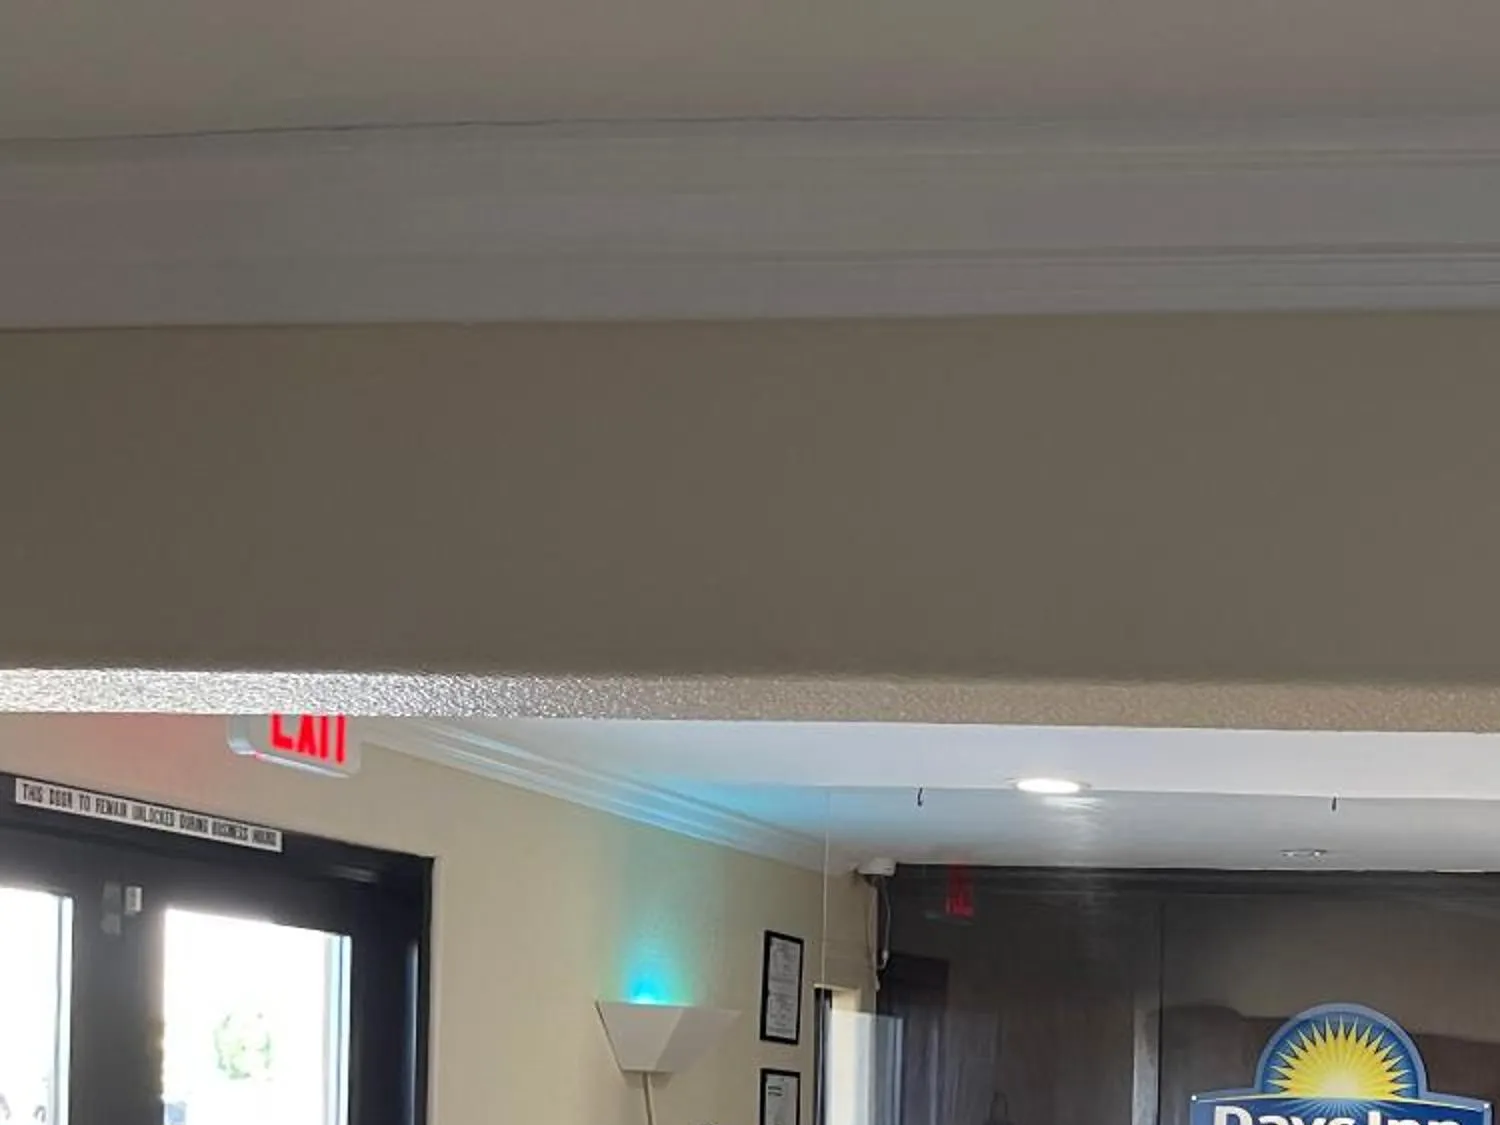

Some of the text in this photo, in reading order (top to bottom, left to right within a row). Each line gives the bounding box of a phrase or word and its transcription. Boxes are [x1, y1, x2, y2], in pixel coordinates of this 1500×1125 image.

[22, 783, 43, 802] THIS
[48, 788, 73, 809] DOOR
[79, 794, 91, 812] TO
